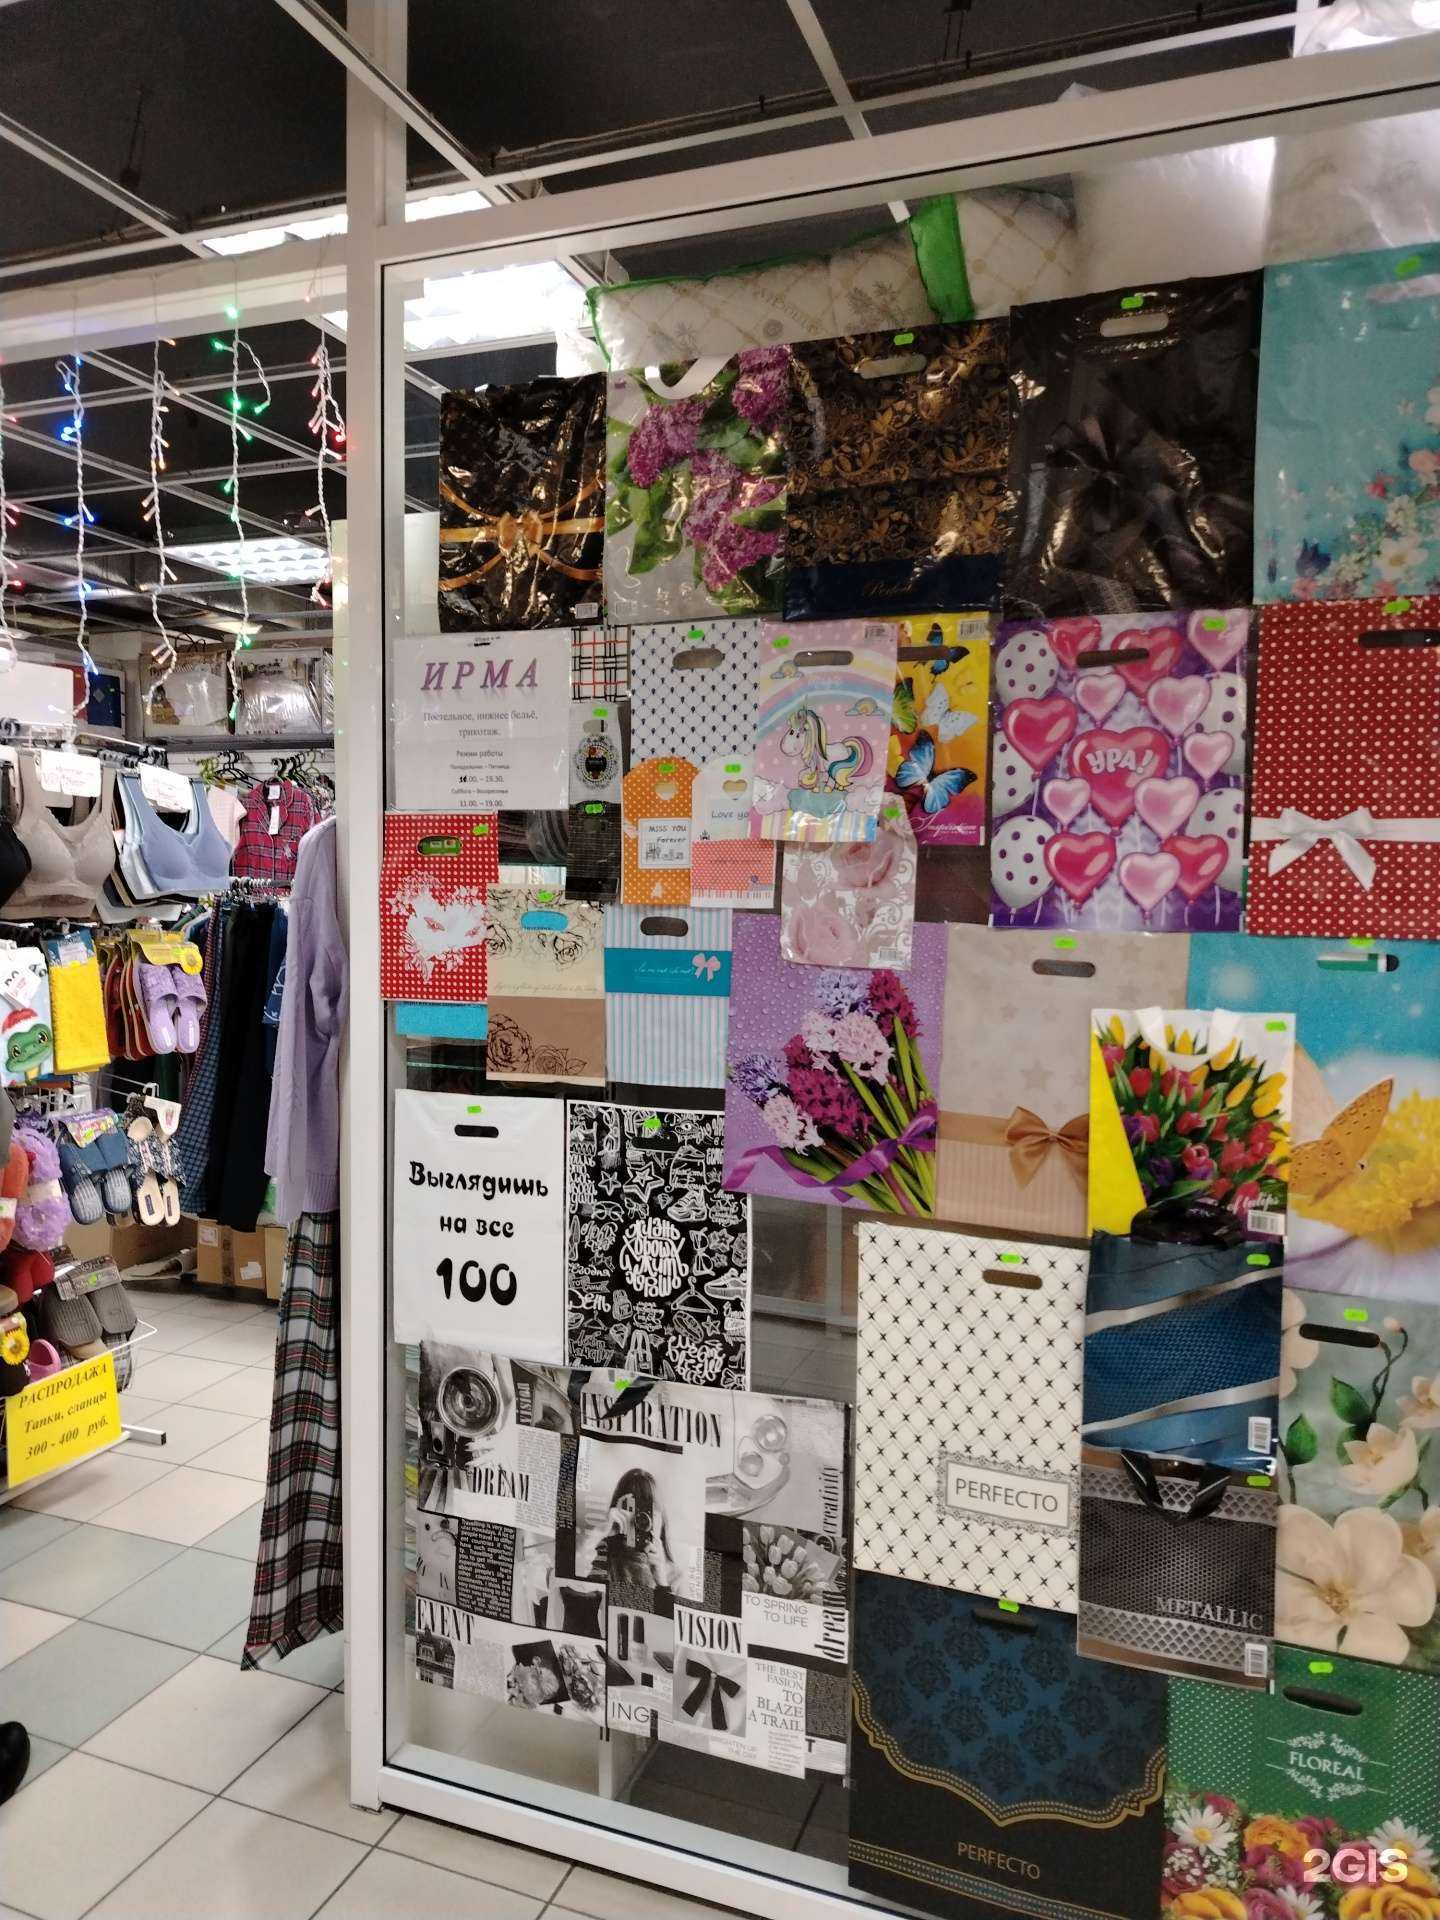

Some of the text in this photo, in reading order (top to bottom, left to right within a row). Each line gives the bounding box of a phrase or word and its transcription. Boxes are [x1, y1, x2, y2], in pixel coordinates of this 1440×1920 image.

[420, 658, 538, 691] ИРМА
[1085, 748, 1154, 774] УРА!
[648, 824, 687, 833] MISS YOU
[408, 1160, 549, 1201] Выглядишь
[440, 1214, 515, 1238] на все
[435, 1257, 518, 1306] 100
[18, 1362, 107, 1409] РАСПРОДАЖА
[26, 1440, 48, 1460] 300
[59, 1427, 79, 1445] 400
[472, 1466, 529, 1502] DREAM
[955, 1477, 1058, 1513] PERFECTO
[744, 1594, 808, 1616] TO SPRING
[763, 1612, 808, 1628] TO LIFE
[1155, 1597, 1264, 1630] METALLIC
[418, 1599, 475, 1646] EVENT
[676, 1609, 743, 1654] VISION
[755, 1662, 805, 1681] THE BEST
[612, 1701, 650, 1723] ING
[757, 1696, 804, 1718] BLAZE
[783, 1689, 803, 1705] TO
[1289, 1752, 1365, 1781] FLOREAL
[957, 1841, 1040, 1880] PERFECTO
